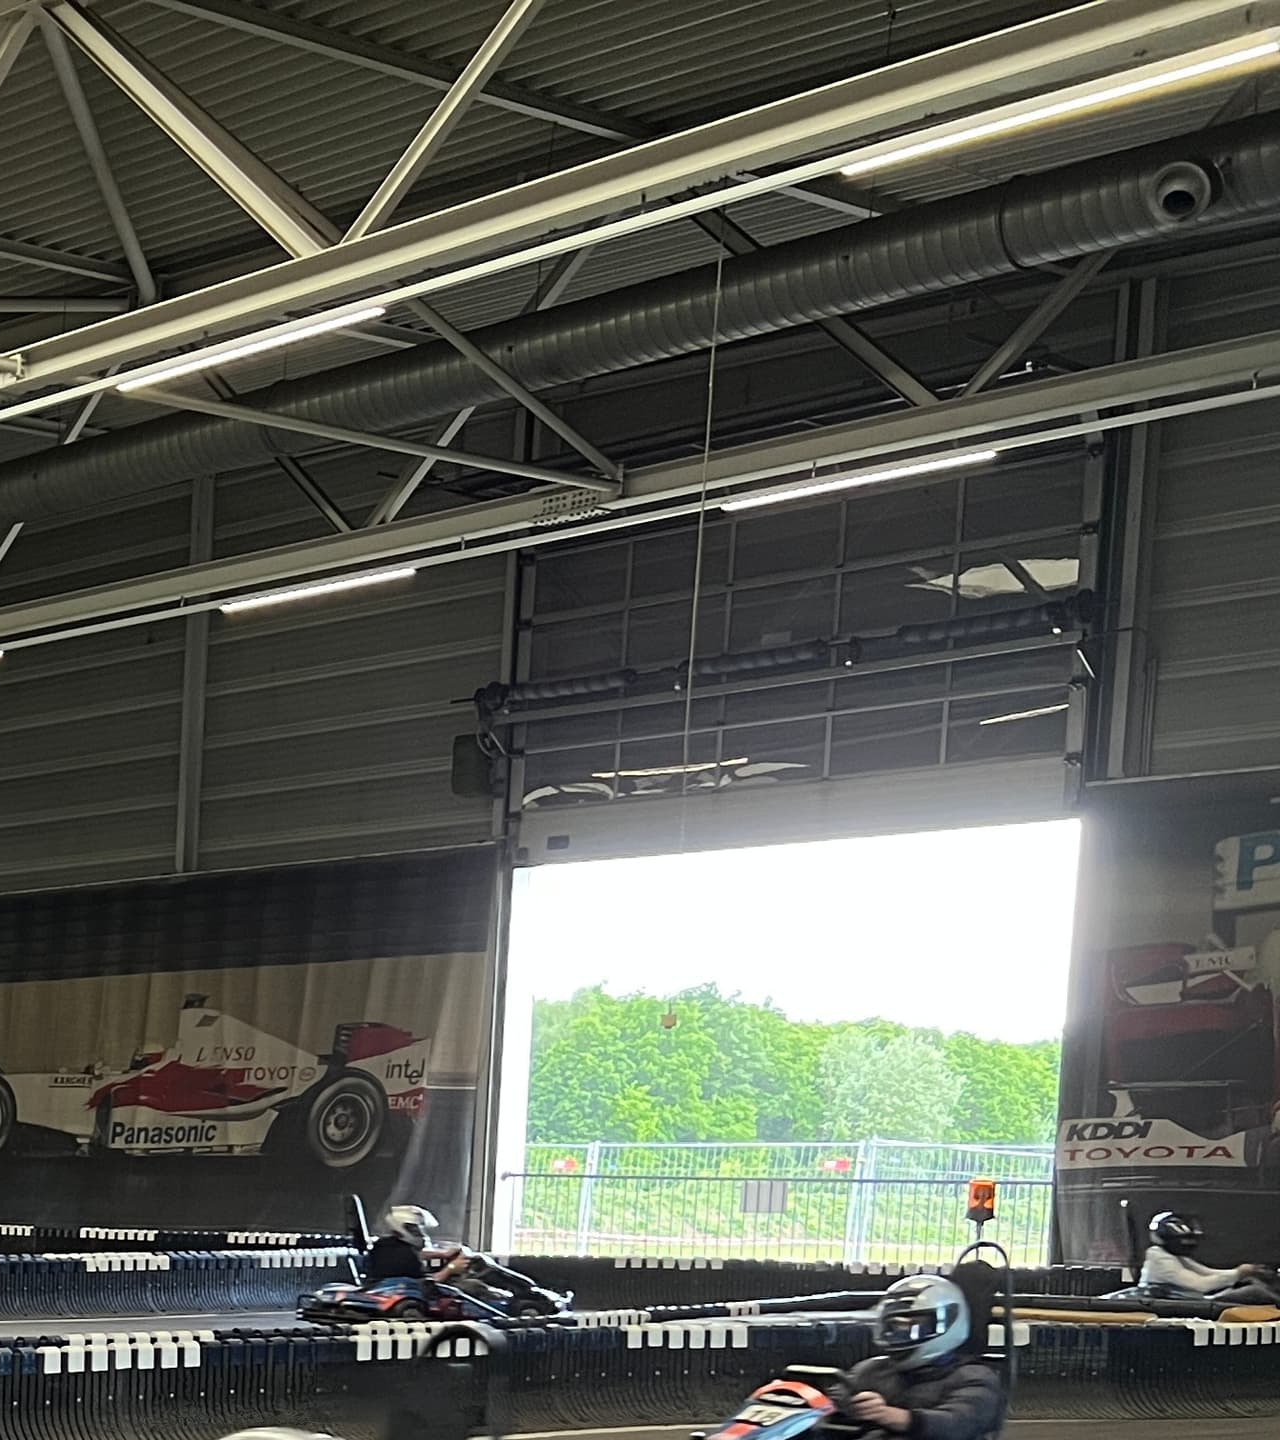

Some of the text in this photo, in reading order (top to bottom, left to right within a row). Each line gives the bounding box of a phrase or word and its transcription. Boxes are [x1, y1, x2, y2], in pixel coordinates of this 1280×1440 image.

[244, 1066, 297, 1081] TOYOT
[385, 1058, 426, 1085] intel
[110, 1120, 217, 1145] Panasonic
[1065, 1121, 1153, 1142] KDDI
[1063, 1145, 1234, 1162] TOYOTA
